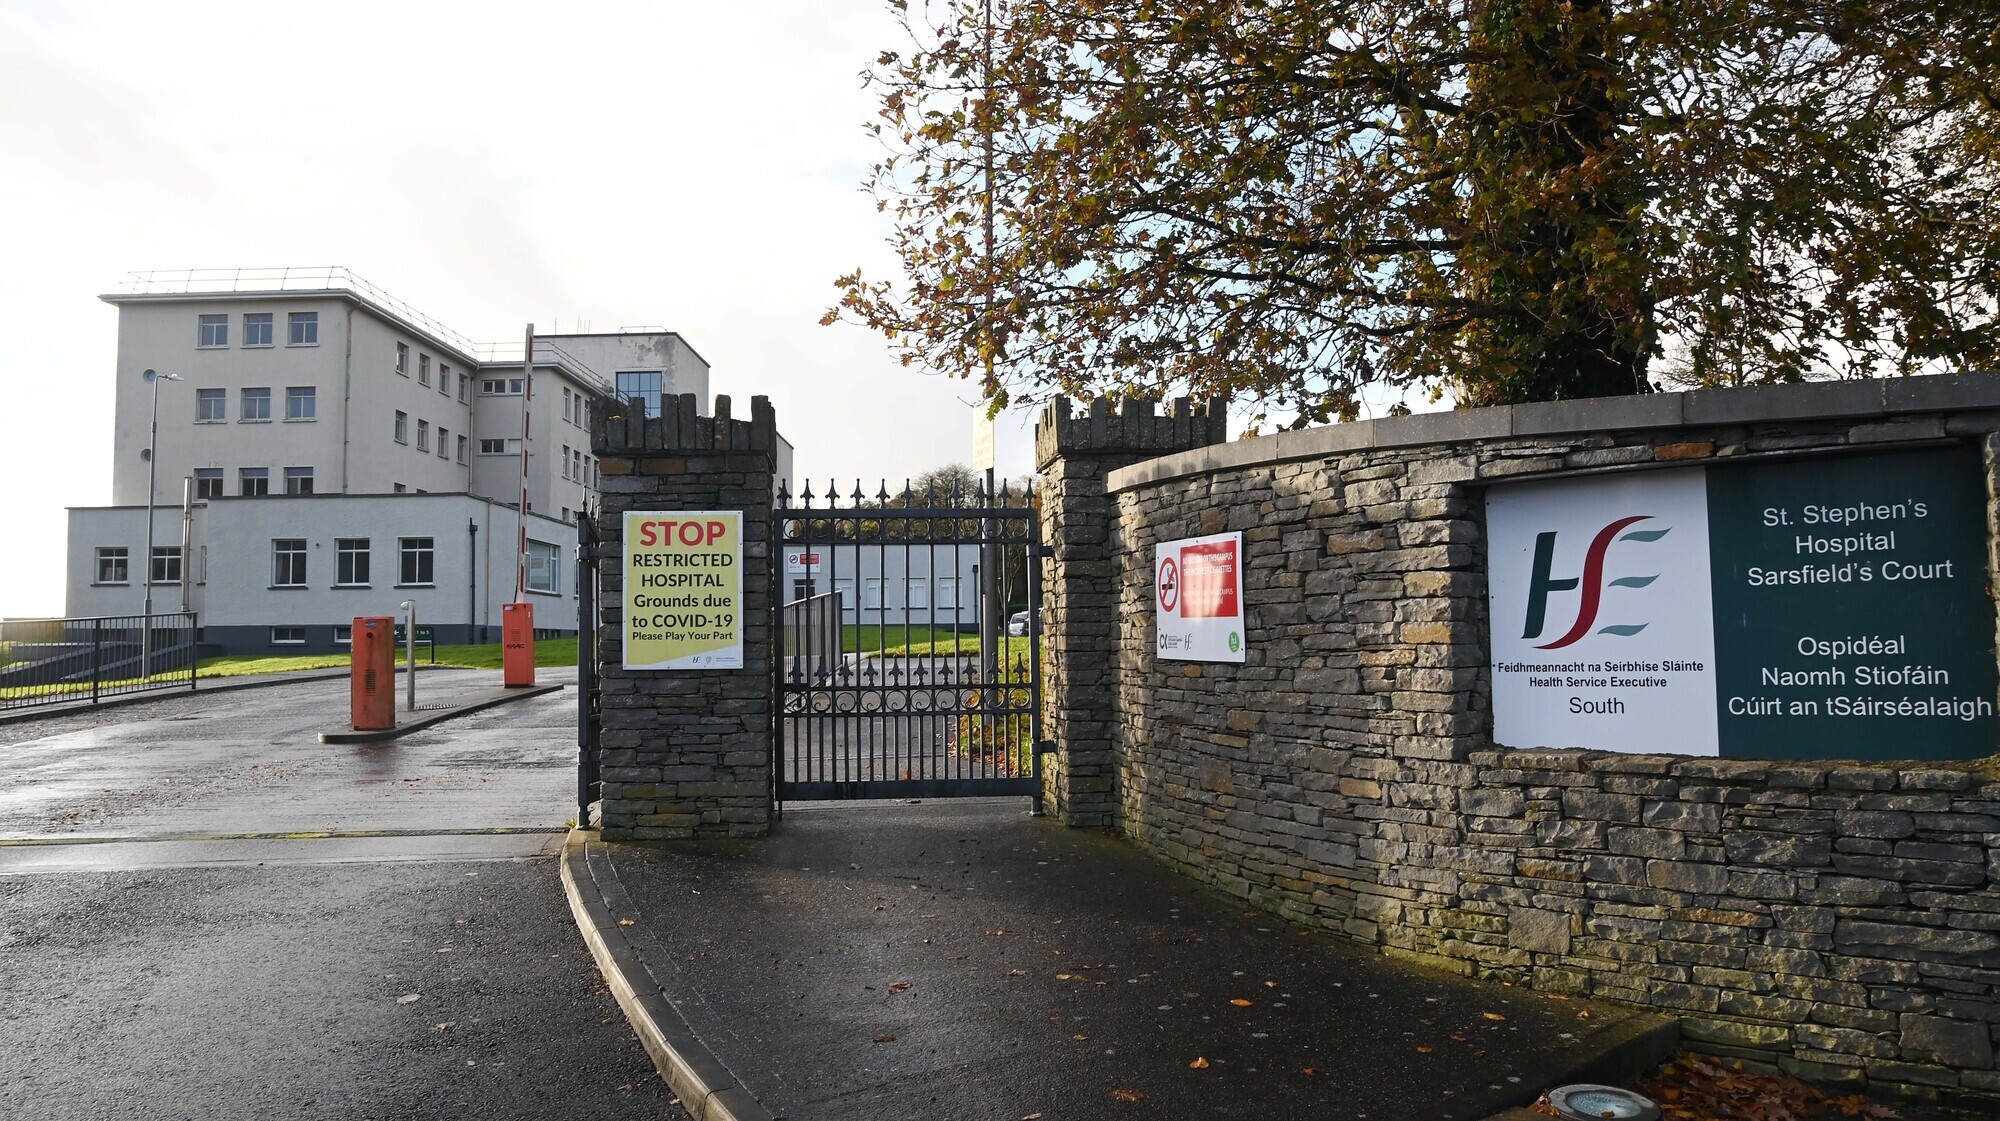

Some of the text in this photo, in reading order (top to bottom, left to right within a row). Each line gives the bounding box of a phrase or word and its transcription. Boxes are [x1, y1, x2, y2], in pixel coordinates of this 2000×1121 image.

[1763, 498, 1928, 527] St. Stephen’s
[640, 521, 726, 546] STOP
[1795, 531, 1896, 556] Hospital
[633, 553, 733, 567] RESTRICTED
[641, 573, 725, 587] HOSPITAL
[1747, 559, 1954, 586] Sarsfield’s Court
[1521, 515, 1672, 650] HSE
[634, 594, 732, 607] Grounds due
[632, 614, 733, 628] to COVID-19
[632, 632, 733, 642] Please Play Your Part
[1797, 635, 1906, 660] Ospidéal
[1498, 660, 1704, 673] Feidhmeannacht na Seirbhíse Sláinte
[1529, 676, 1667, 688] Health Service Executive
[1761, 666, 1949, 686] Naomh Stiofáin
[1569, 697, 1625, 714] South
[1728, 696, 1993, 721] Cúirt an tSáirséalaigh
